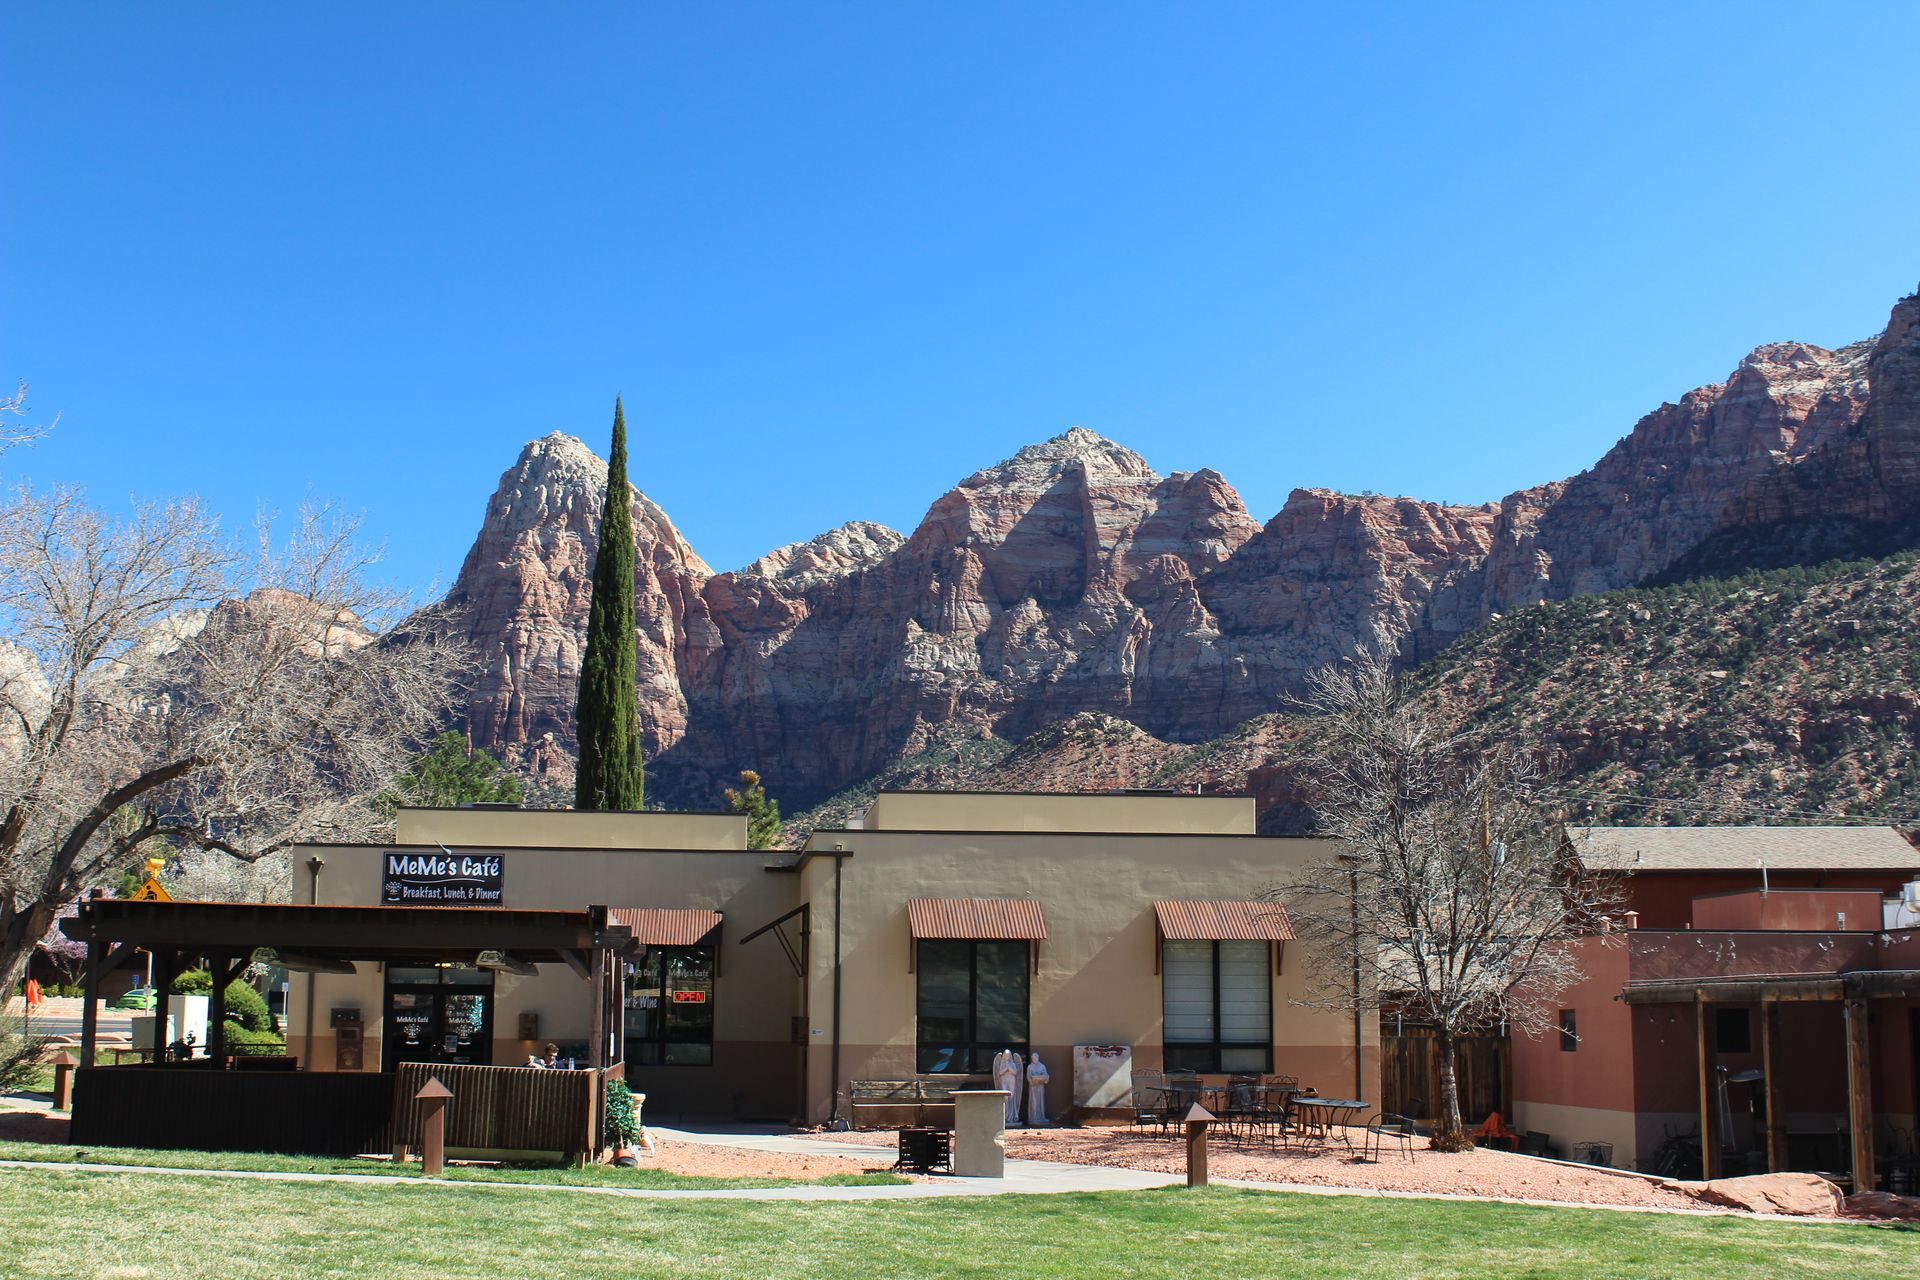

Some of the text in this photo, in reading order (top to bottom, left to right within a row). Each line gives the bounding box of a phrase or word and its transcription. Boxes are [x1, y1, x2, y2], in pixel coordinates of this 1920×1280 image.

[389, 855, 499, 876] MeMe's Café
[403, 886, 501, 900] Breakfast, Lunch, & Dinner
[632, 996, 639, 1007] &
[640, 995, 658, 1009] Wine
[674, 992, 704, 1002] OPEN
